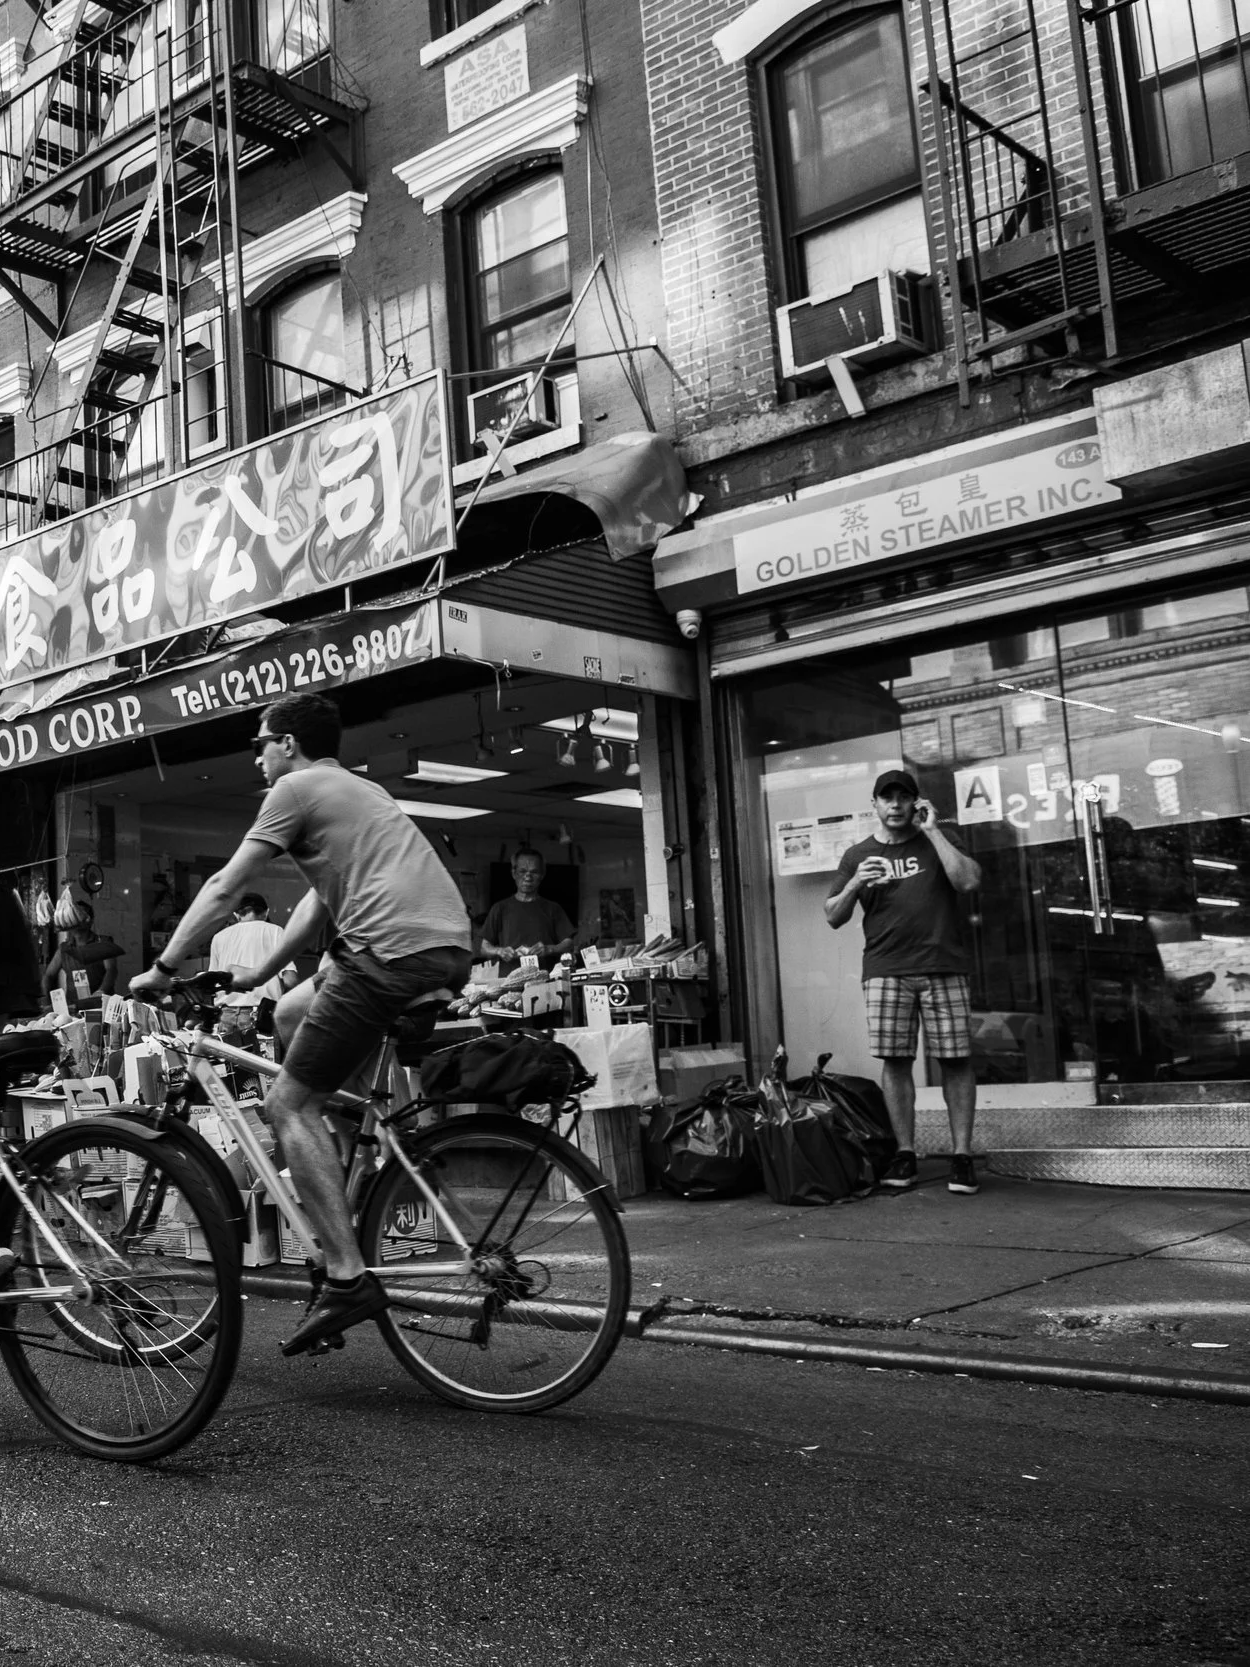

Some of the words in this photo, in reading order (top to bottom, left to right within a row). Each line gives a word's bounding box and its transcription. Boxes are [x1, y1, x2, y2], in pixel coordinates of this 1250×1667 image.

[459, 38, 510, 78] ASA
[1058, 448, 1085, 466] 143
[756, 535, 871, 583] GOLDEN
[880, 495, 1029, 552] STEAMER
[1037, 478, 1102, 513] INC.
[49, 694, 145, 754] CORP.
[171, 679, 221, 718] Tel:
[220, 657, 287, 706] (212)
[965, 775, 992, 808] A
